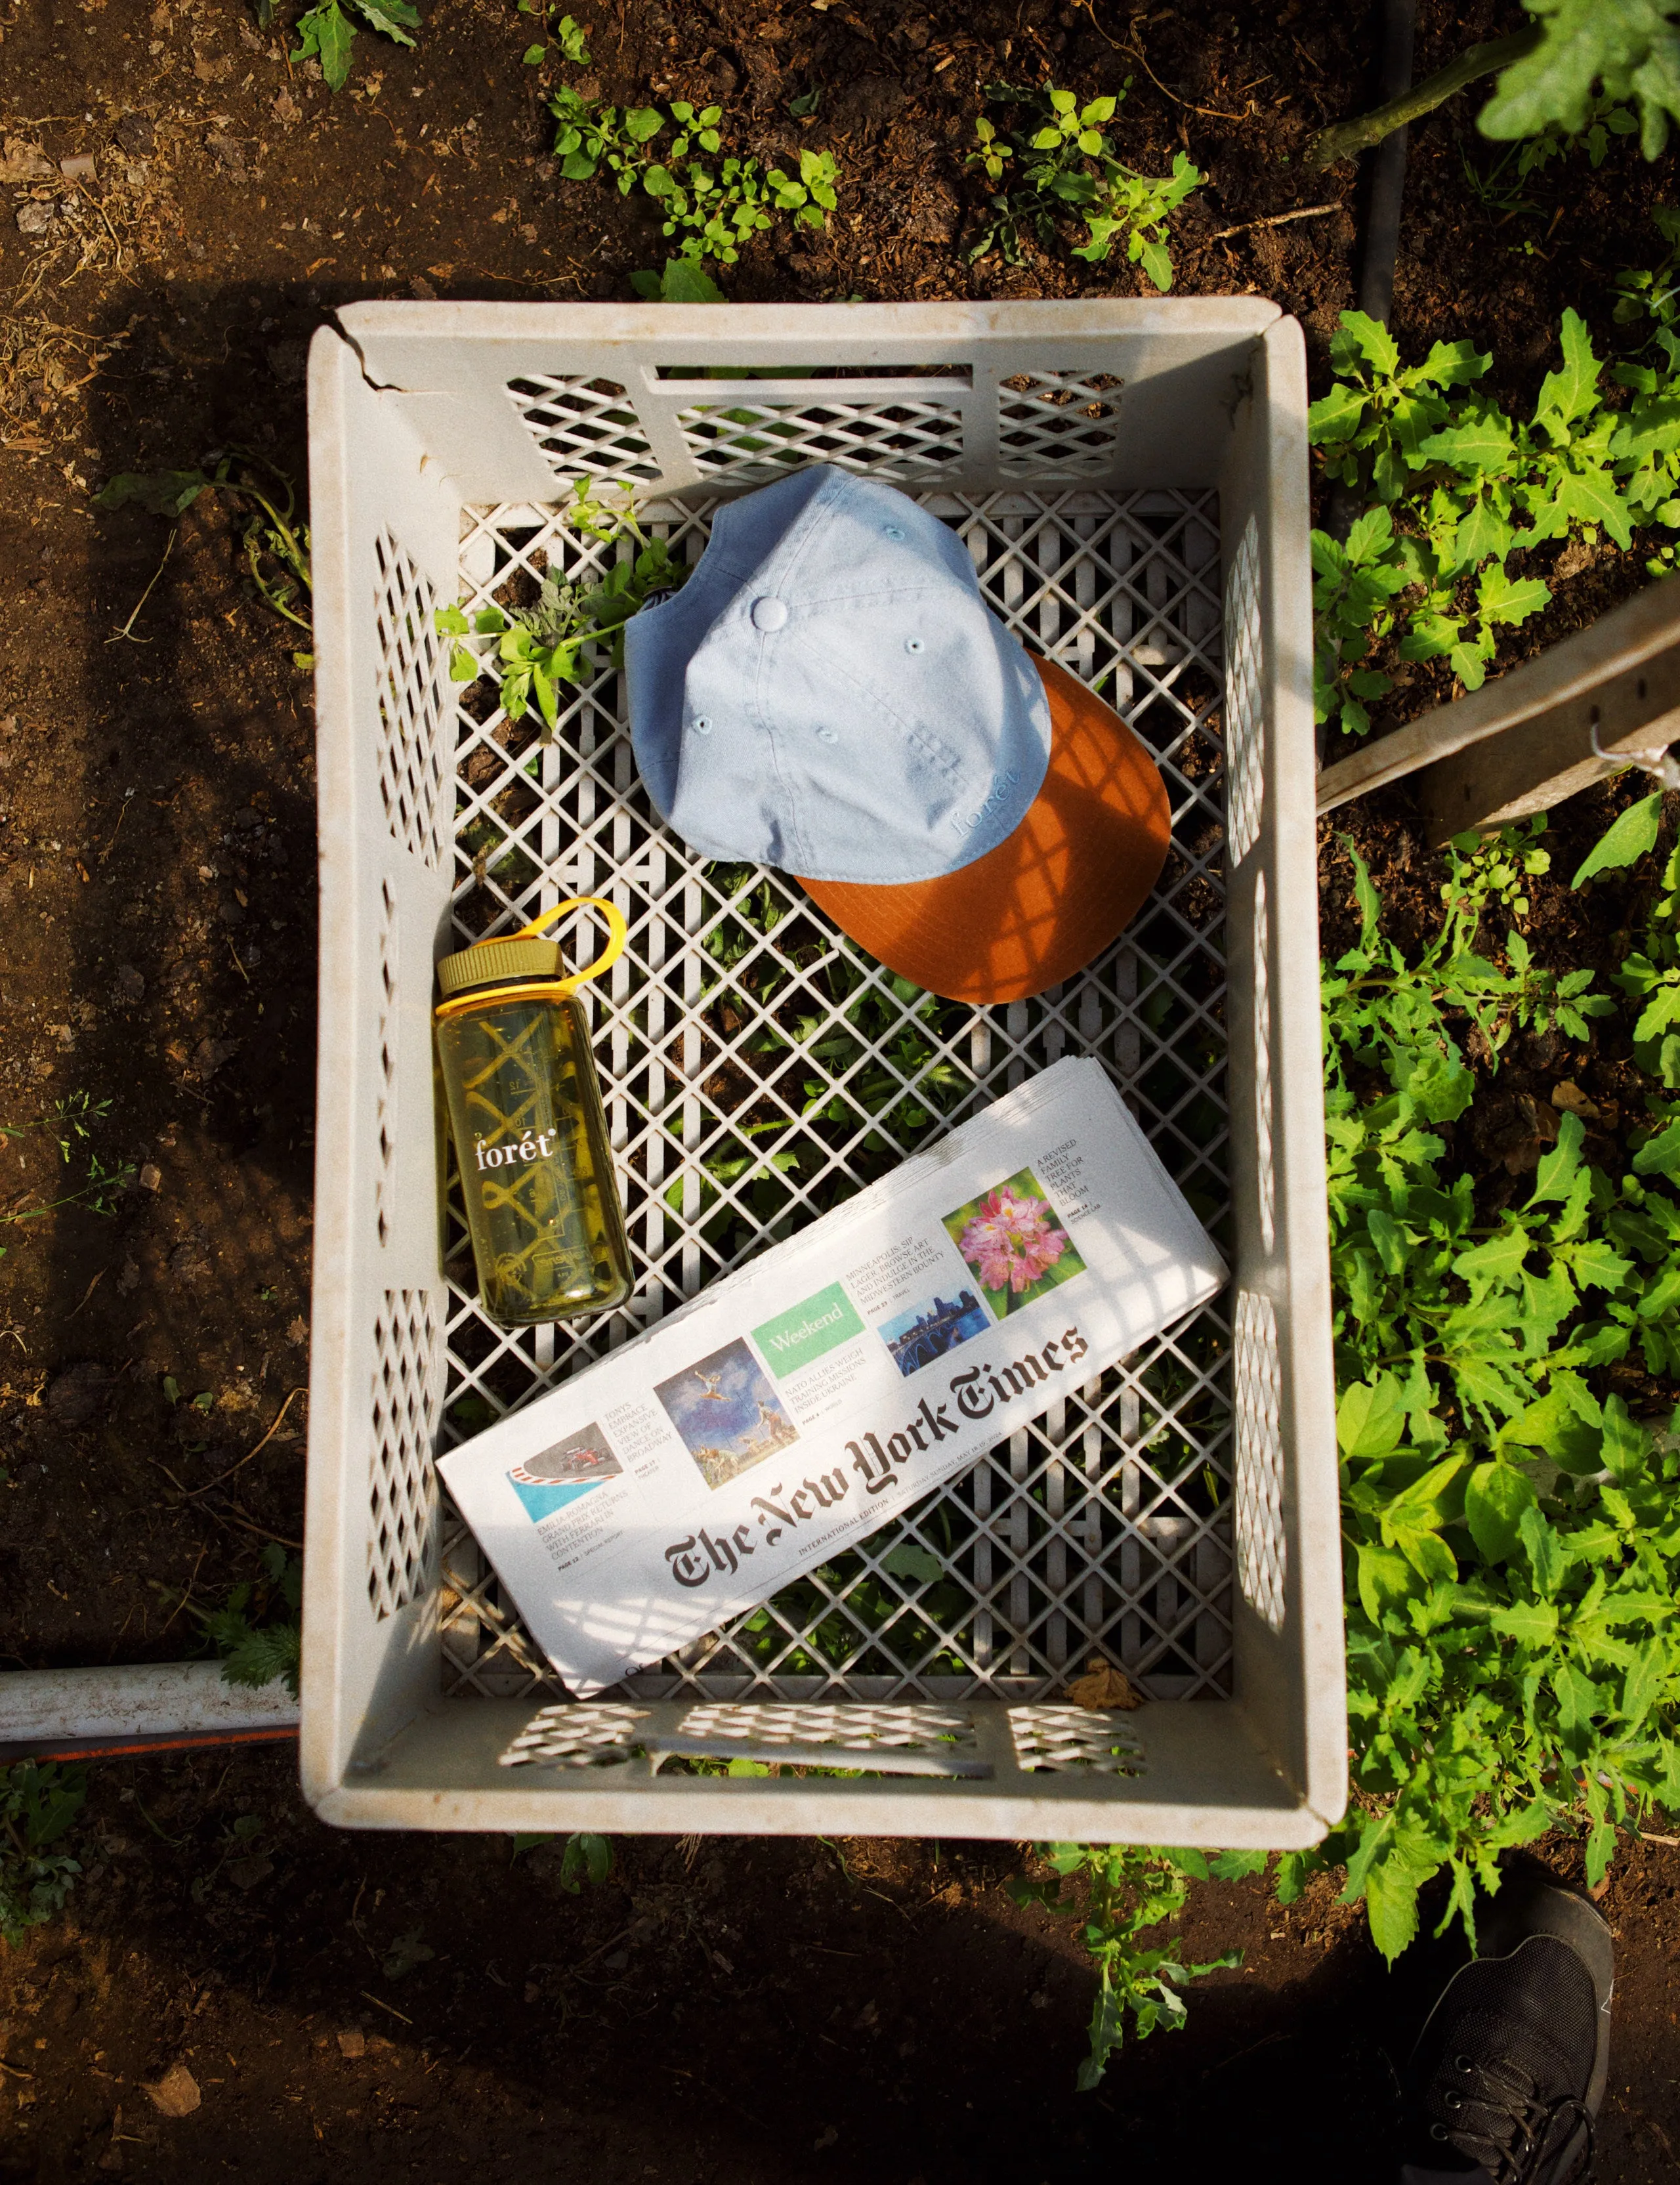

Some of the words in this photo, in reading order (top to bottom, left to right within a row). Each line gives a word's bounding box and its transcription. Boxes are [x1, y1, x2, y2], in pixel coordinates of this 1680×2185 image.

[1040, 1153, 1070, 1174] FAMILY
[1043, 1138, 1077, 1162] REVISED
[1045, 1166, 1067, 1182] TREE
[1066, 1156, 1083, 1170] FOR
[1049, 1168, 1082, 1190] PLANTS
[1054, 1181, 1077, 1199] THAT
[1059, 1185, 1089, 1206] BLOOM
[1067, 1208, 1080, 1218] PAGE
[1070, 1209, 1091, 1224] SCIENCE
[1091, 1203, 1101, 1212] LAB
[846, 1244, 902, 1281] MINNEAPOLIS:
[900, 1237, 914, 1248] SIP
[879, 1248, 913, 1272] BROWSE
[912, 1238, 930, 1252] ART
[855, 1282, 873, 1296] AND
[873, 1262, 908, 1286] INDULGE
[908, 1256, 917, 1265] IN
[917, 1246, 934, 1260] THE
[860, 1269, 913, 1305] MIDWESTERN
[912, 1250, 945, 1274] BOUNTY
[867, 1305, 881, 1315] PAGE
[892, 1287, 910, 1300] TRAVEL
[769, 1303, 843, 1353] Weekend
[785, 1380, 808, 1397] NATO
[807, 1363, 835, 1384] ALLIES
[835, 1347, 863, 1367] WEIGH
[789, 1378, 829, 1405] TRAINING
[828, 1357, 866, 1382] MISSIONS
[794, 1393, 822, 1413] INSIDE
[821, 1373, 857, 1397] UKRAINE
[603, 1402, 631, 1422] TONYS
[608, 1403, 647, 1429] EMBRACE
[613, 1408, 658, 1437] EXPANSIVE
[802, 1414, 815, 1425] PAGE
[617, 1429, 640, 1446] VIEW
[639, 1422, 652, 1433] OF
[621, 1433, 650, 1454] DANCE
[650, 1426, 664, 1438] ON
[627, 1432, 673, 1462] BROADWAY
[664, 1525, 757, 1588] The
[749, 1466, 849, 1547] New
[845, 1397, 960, 1495] York
[950, 1326, 1089, 1420] Times
[541, 1522, 571, 1544] GRAND
[571, 1510, 591, 1526] PRIX
[590, 1489, 628, 1515] RETURNS
[546, 1535, 569, 1552] WITH
[569, 1514, 604, 1538] FERRARI
[603, 1508, 614, 1518] IN
[798, 1516, 858, 1556] INTERNATIONAL
[858, 1498, 889, 1519] EDITION
[550, 1526, 604, 1561] CONTENTION
[557, 1560, 572, 1571] PAGE
